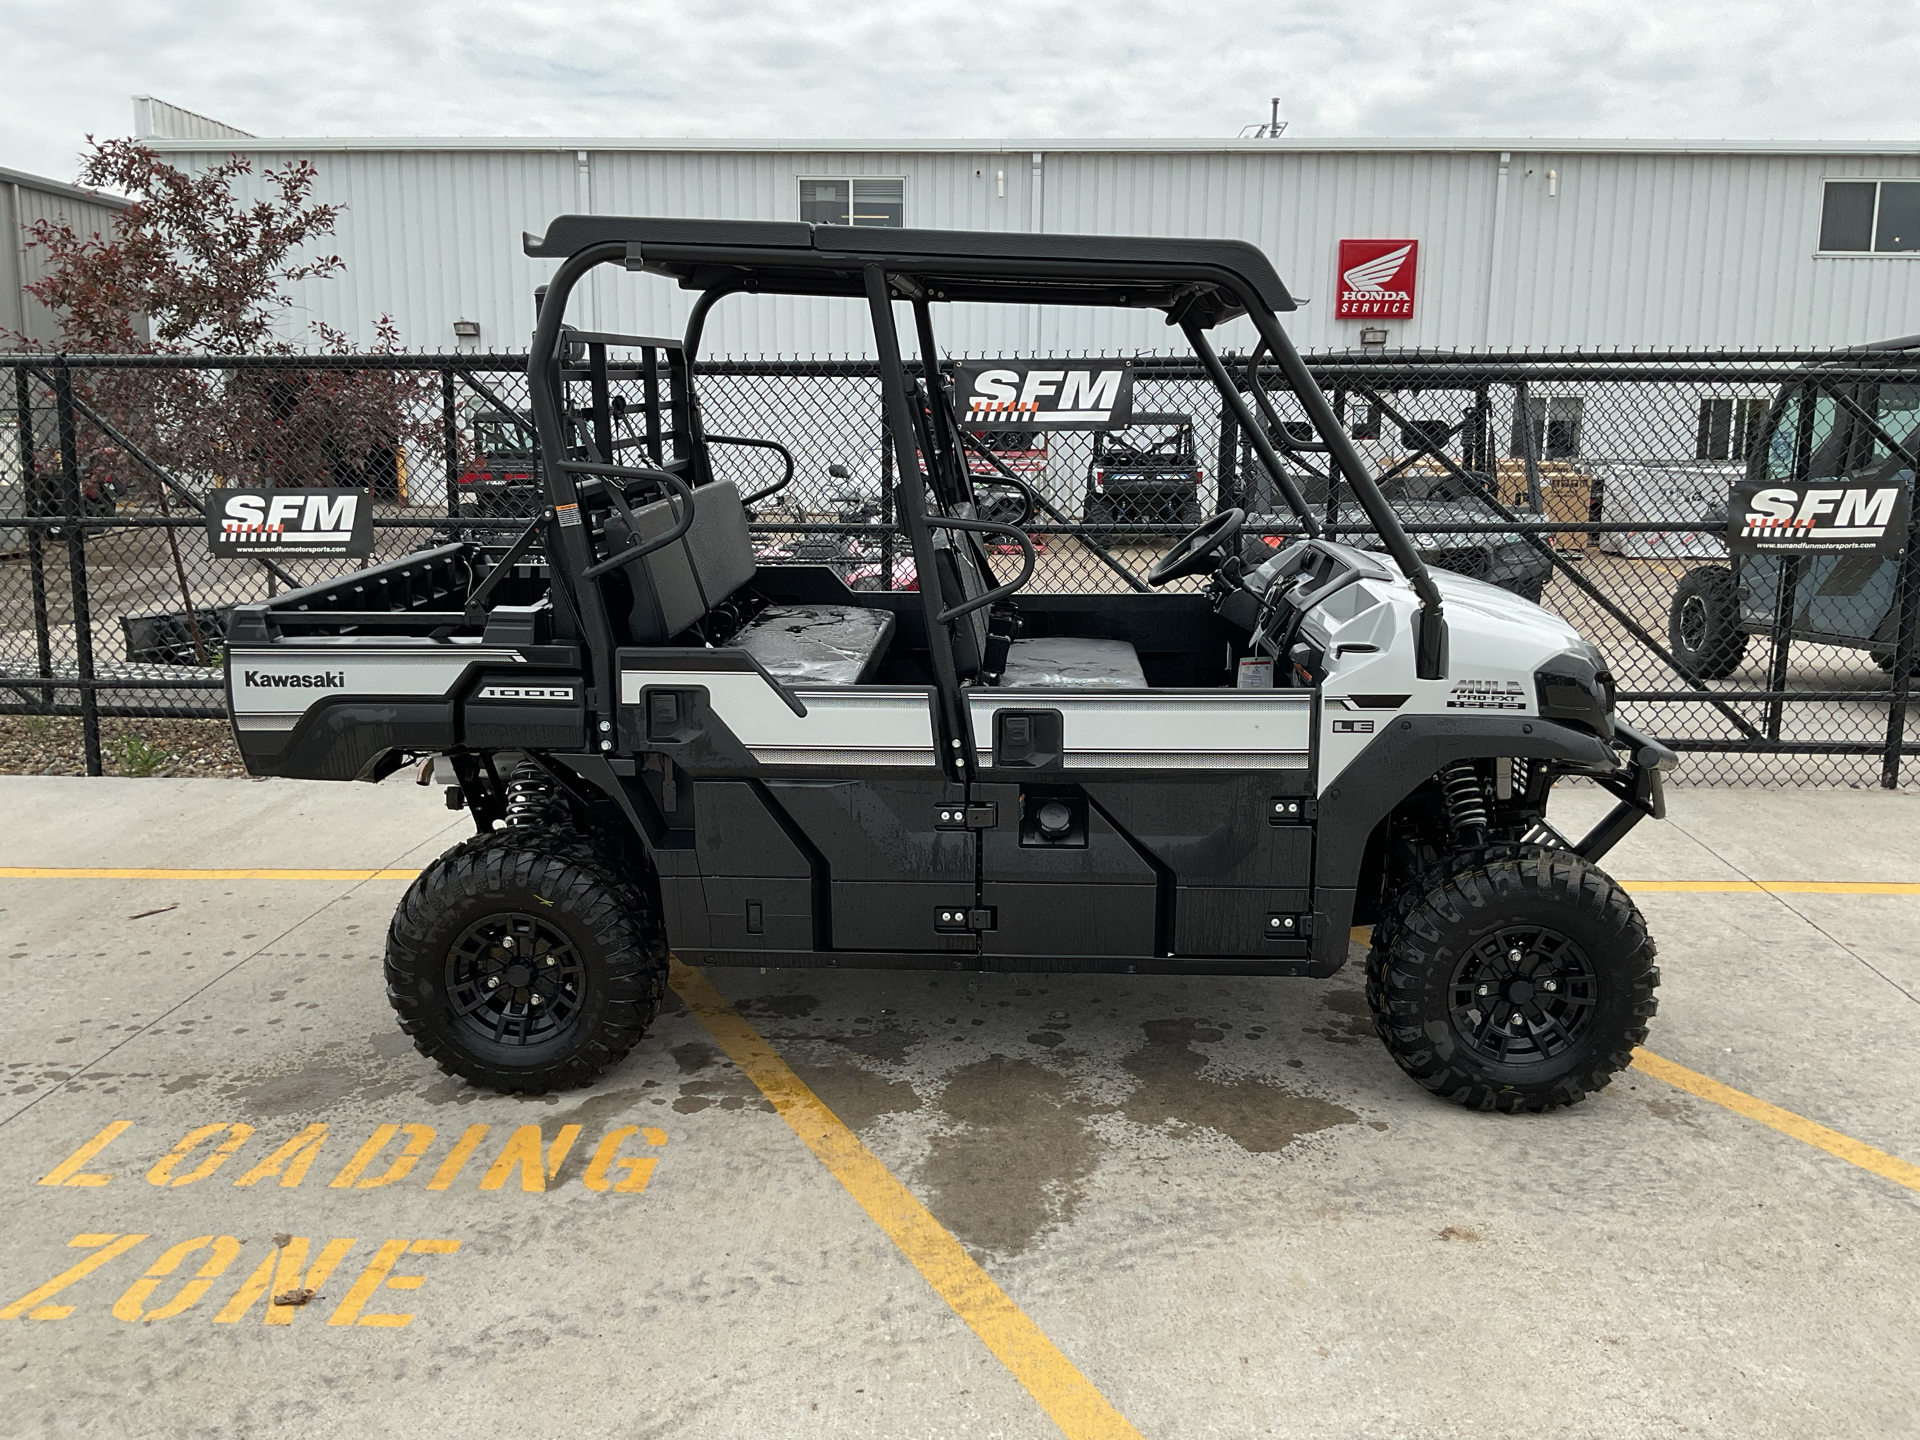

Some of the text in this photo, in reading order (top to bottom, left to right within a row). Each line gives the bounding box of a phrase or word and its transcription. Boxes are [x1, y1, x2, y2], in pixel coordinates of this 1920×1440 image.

[1341, 291, 1410, 301] HONDA
[1341, 302, 1410, 313] SERVICE
[969, 369, 1123, 410] SFM
[221, 495, 358, 531] SFM
[1745, 488, 1898, 526] SFM
[236, 545, 347, 553] www.sunandfunmotorsports.com
[1756, 541, 1877, 550] www.sunandfunmotorsports.com
[244, 670, 345, 688] Kawasaki
[487, 689, 570, 697] 1000
[1450, 679, 1525, 695] MULE
[1456, 694, 1518, 702] PRO-FXT
[1453, 701, 1520, 709] 1000
[1334, 721, 1374, 733] LE
[38, 1120, 670, 1194] LOADING
[0, 1233, 462, 1328] ZONE
